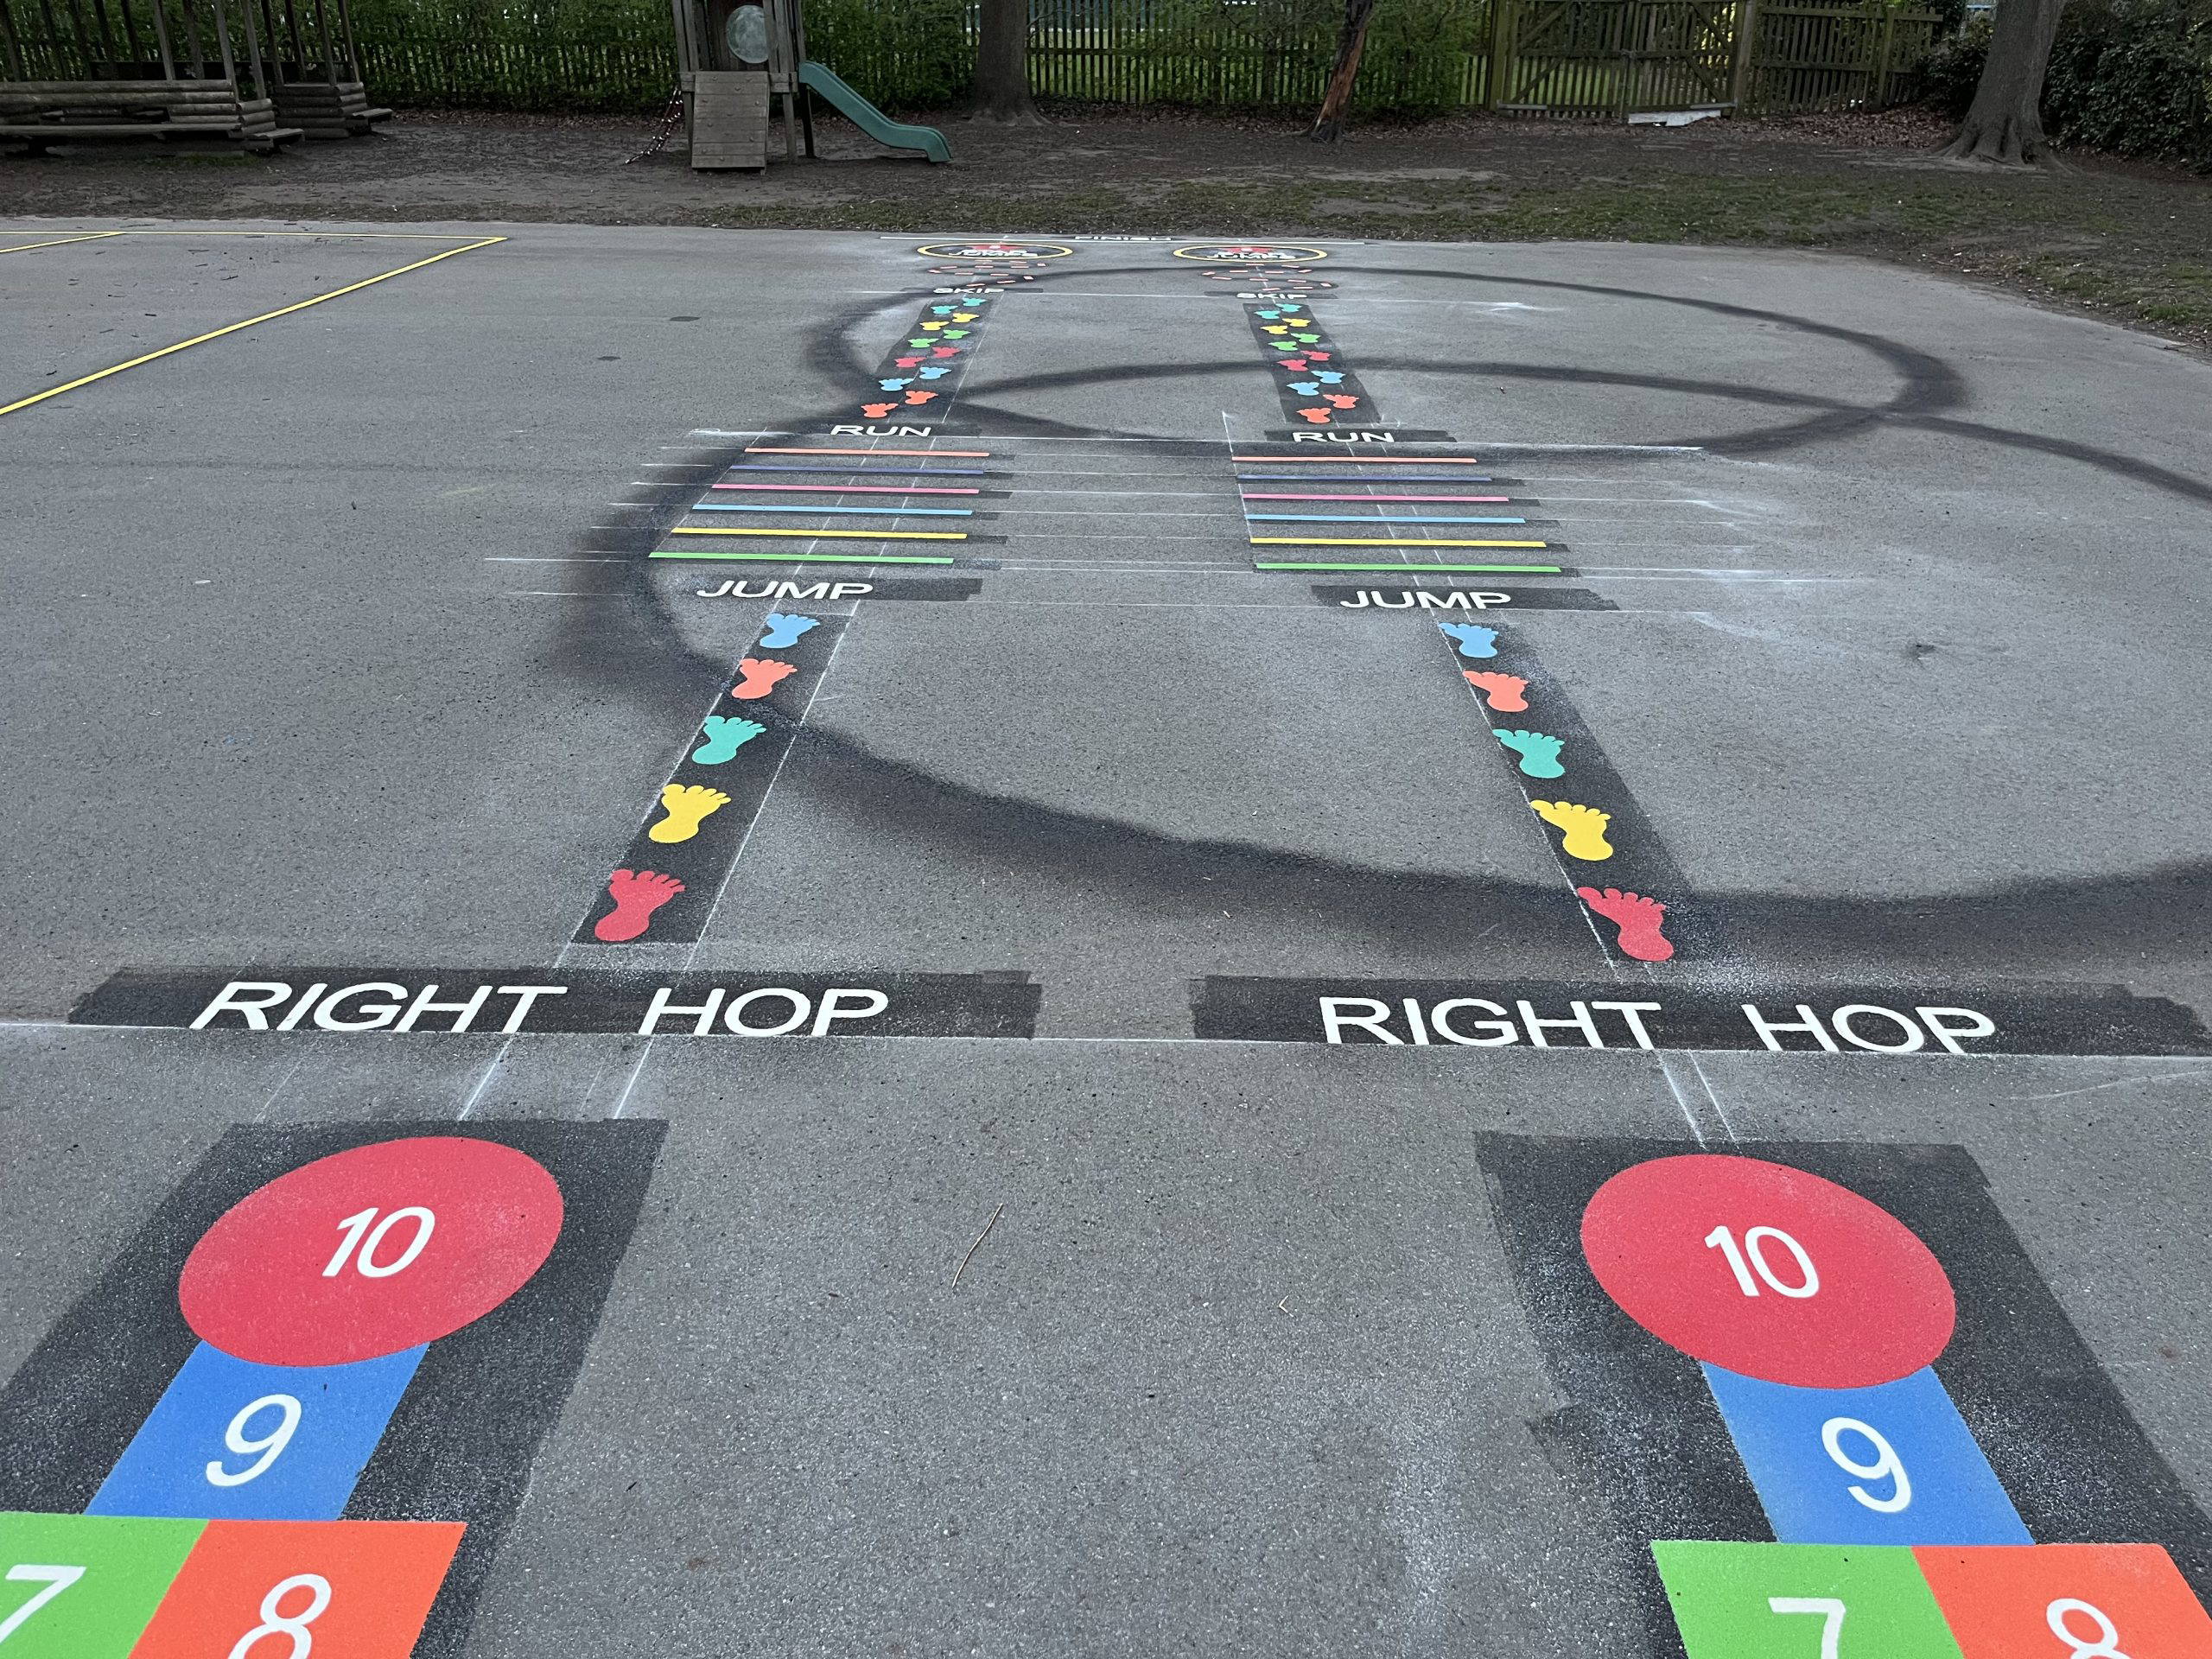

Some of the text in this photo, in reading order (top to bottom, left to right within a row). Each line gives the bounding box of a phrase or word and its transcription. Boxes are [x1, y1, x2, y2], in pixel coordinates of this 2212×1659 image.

[830, 424, 931, 437] RUN
[1292, 431, 1395, 443] RUN
[696, 580, 874, 600] JUMP
[1339, 590, 1511, 610] JUMP
[188, 982, 890, 1039] RIGHT HOP
[1318, 996, 1996, 1058] RIGHT HOP
[322, 1206, 435, 1278] 10
[1704, 1225, 1820, 1298] 10
[206, 1394, 302, 1487] 9
[1821, 1417, 1911, 1513] 9
[0, 1565, 86, 1643] 7
[227, 1573, 332, 1659] 8
[1768, 1597, 1847, 1659] 7
